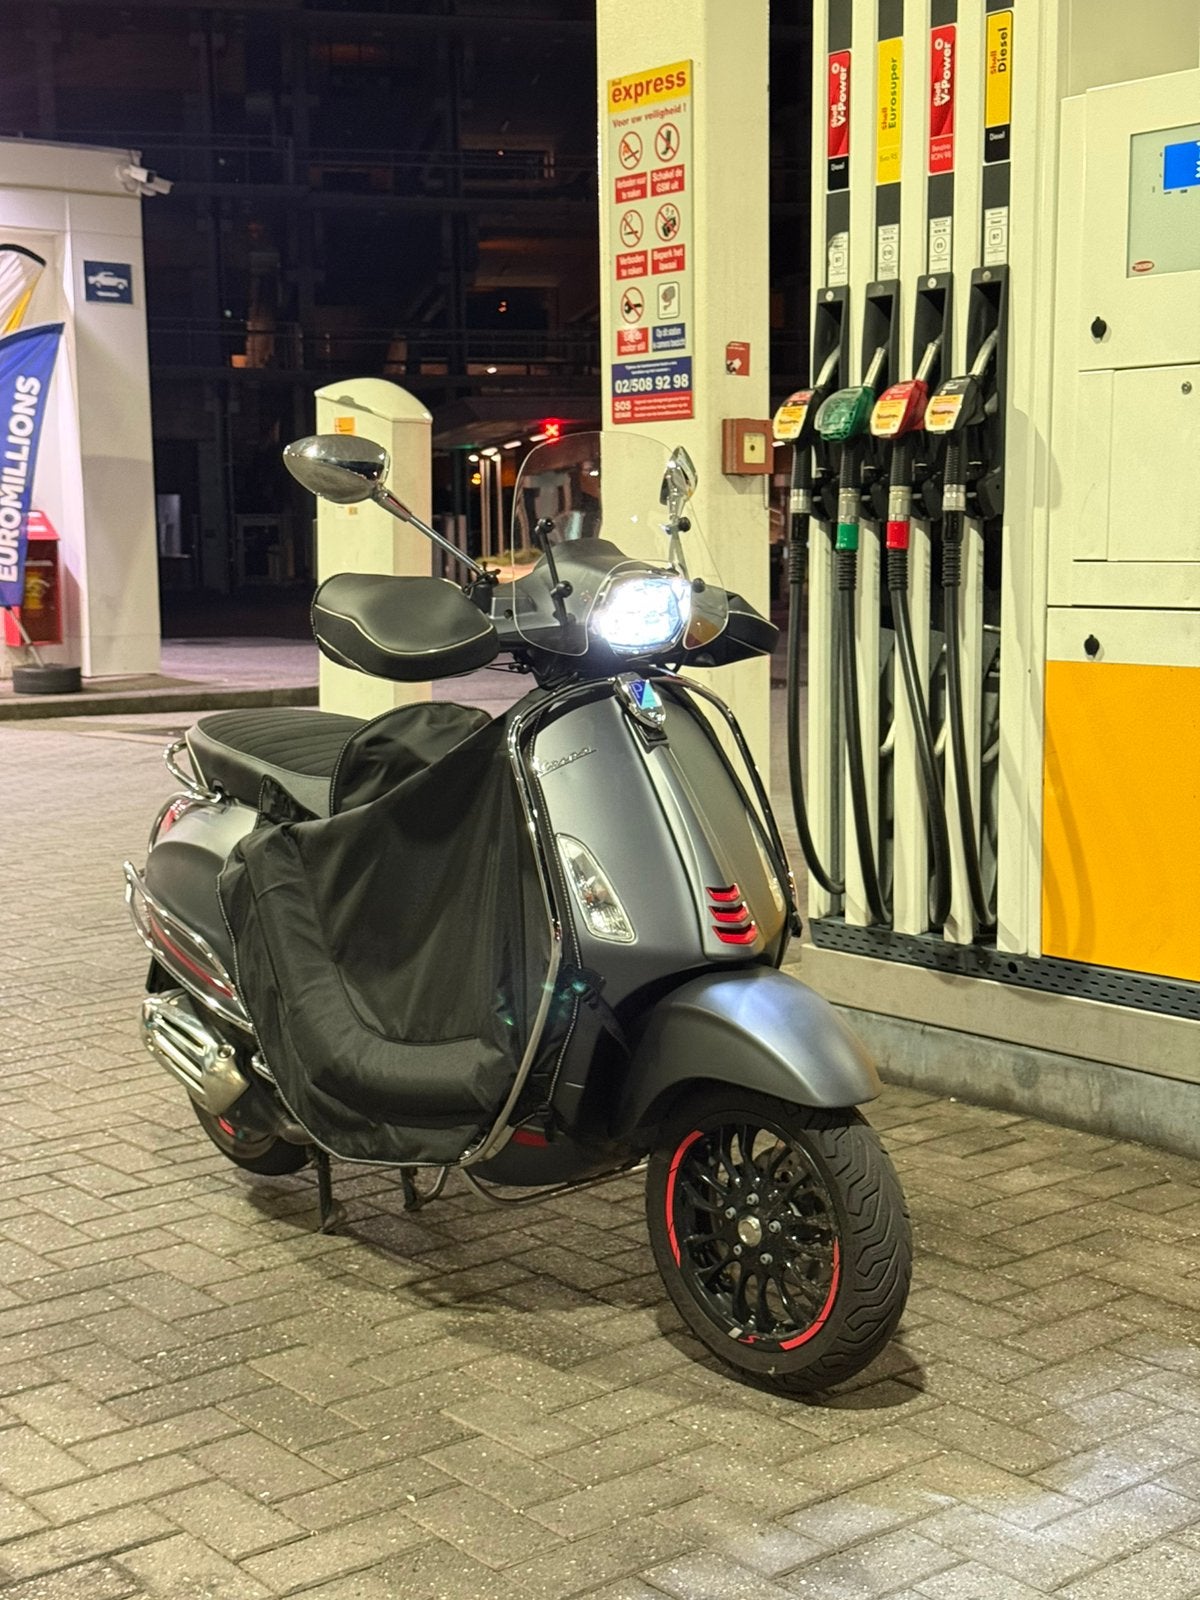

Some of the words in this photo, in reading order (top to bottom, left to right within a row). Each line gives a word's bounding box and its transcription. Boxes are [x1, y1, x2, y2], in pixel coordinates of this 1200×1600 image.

[940, 41, 951, 106] V-Power
[997, 27, 1008, 73] Diesel
[612, 71, 686, 103] express
[837, 66, 847, 127] V-Power
[888, 57, 899, 129] Eurosuper
[614, 377, 653, 394] 02/508
[655, 375, 671, 390] 92
[673, 373, 689, 388] 98
[614, 400, 632, 411] SOS
[0, 375, 41, 583] EUROMILLIONS
